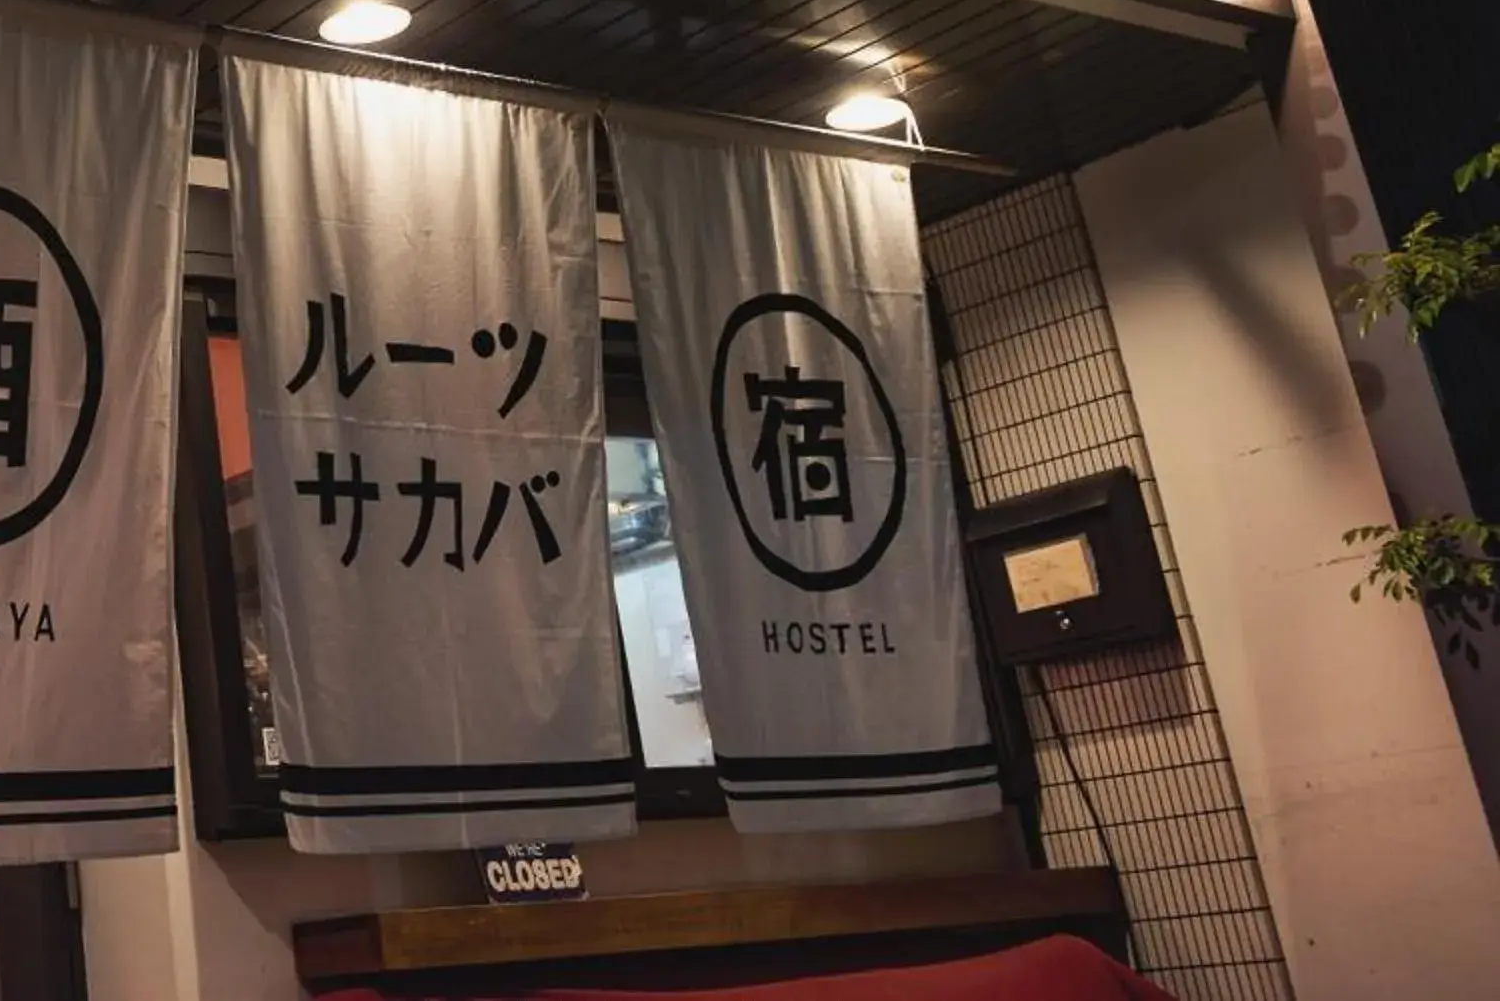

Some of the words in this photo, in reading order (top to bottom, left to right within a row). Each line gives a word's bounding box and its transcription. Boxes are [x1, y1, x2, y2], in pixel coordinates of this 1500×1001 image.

[286, 293, 547, 419] ルーツ
[745, 365, 854, 524] 宿
[294, 451, 561, 572] サカバ
[761, 620, 895, 655] HOSTEL
[487, 856, 582, 892] CLOSED
